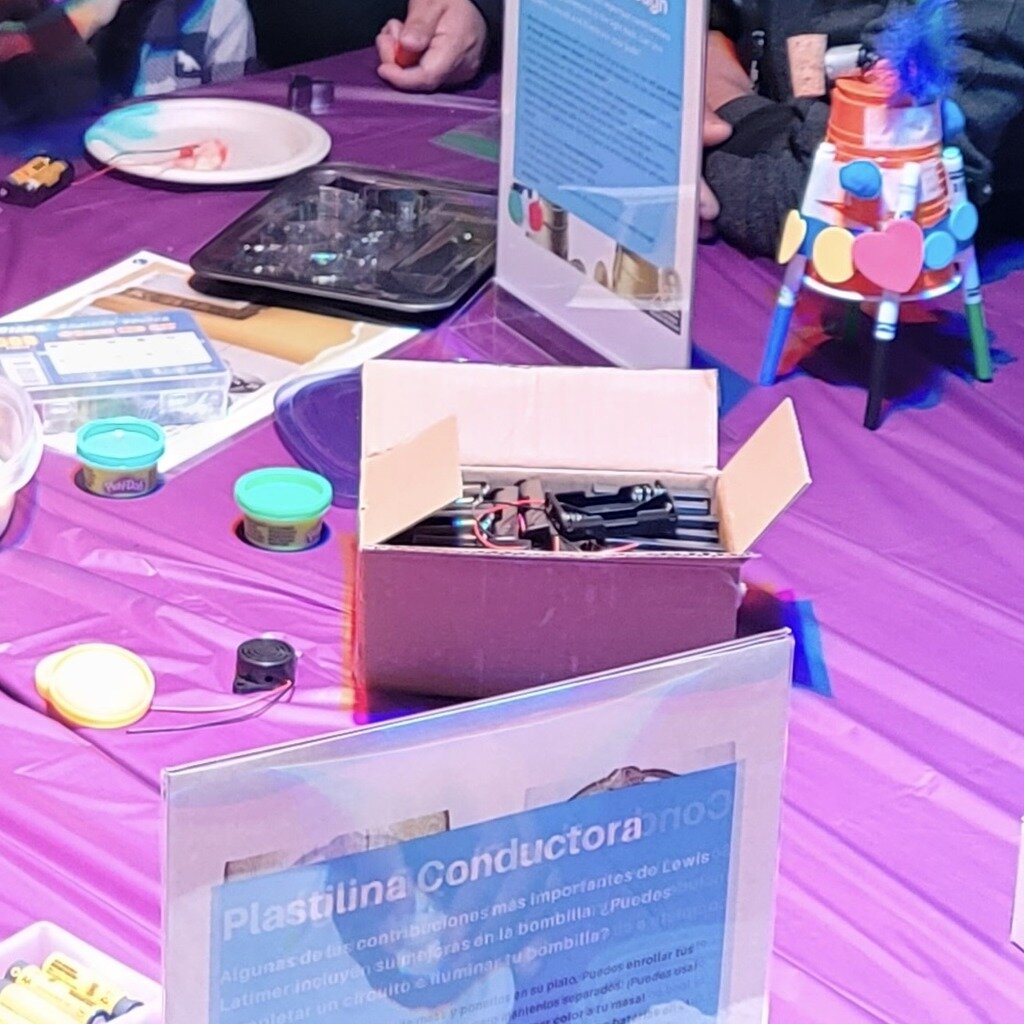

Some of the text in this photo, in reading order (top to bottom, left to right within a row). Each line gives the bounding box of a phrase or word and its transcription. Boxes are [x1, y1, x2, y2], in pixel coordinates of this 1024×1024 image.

[221, 956, 297, 984] Algunas
[299, 948, 323, 965] de
[356, 908, 489, 951] contribuciones
[530, 870, 633, 907] importantes
[637, 864, 658, 879] de
[662, 852, 711, 874] Lewis
[223, 816, 642, 942] Plastilina Conductora
[220, 984, 291, 1013] Latimer
[295, 965, 372, 995] incluyen
[473, 932, 494, 948] en
[499, 927, 514, 941] la
[600, 887, 673, 917] ¿Puedes
[317, 998, 338, 1015] un
[530, 984, 545, 997] su
[582, 963, 624, 981] Puedes
[626, 950, 673, 971] enrollar
